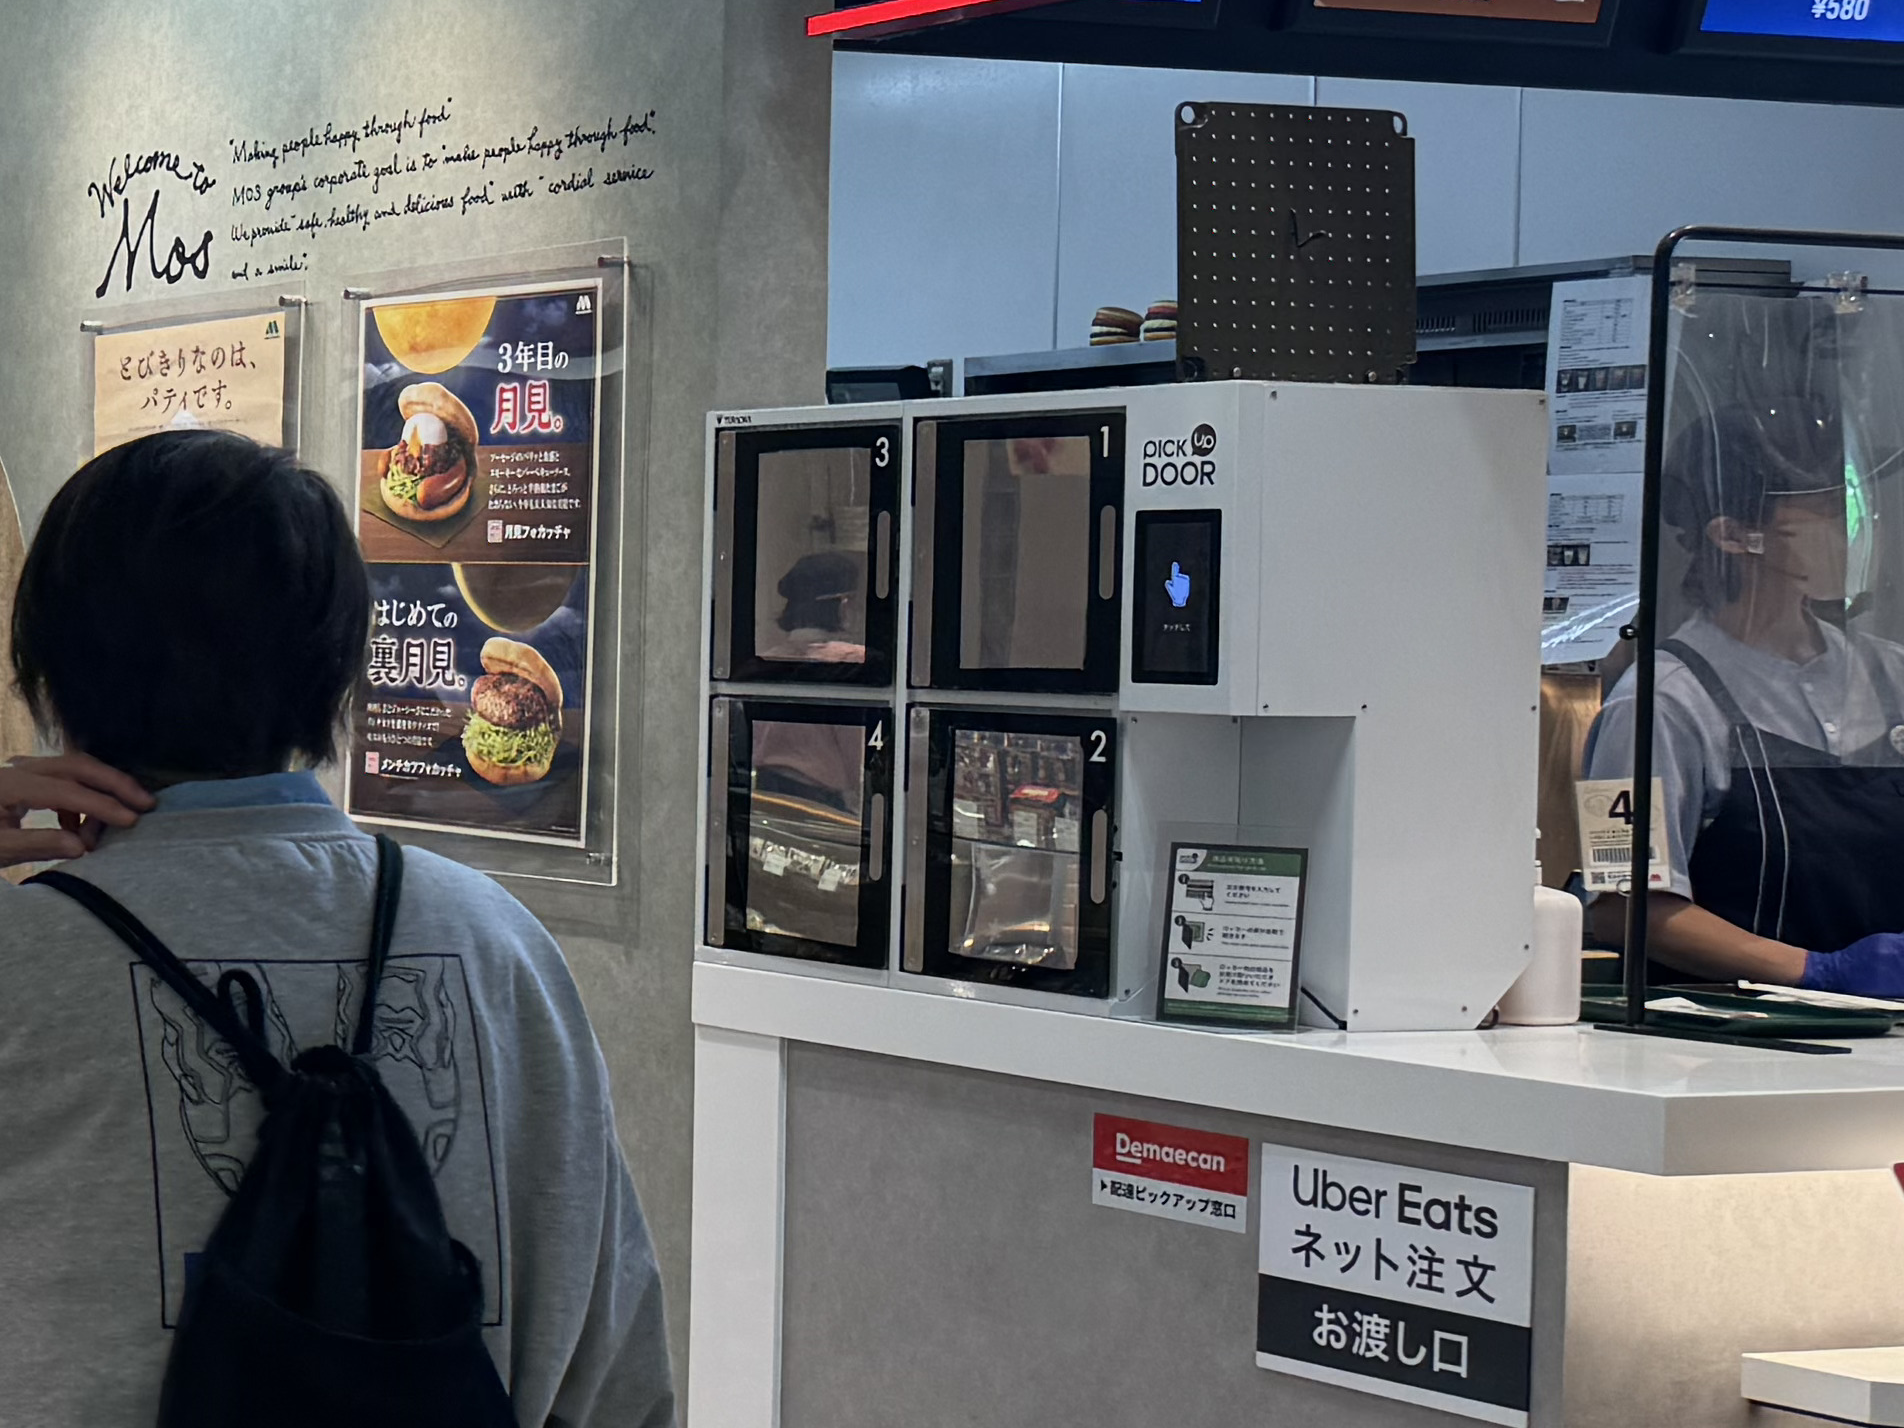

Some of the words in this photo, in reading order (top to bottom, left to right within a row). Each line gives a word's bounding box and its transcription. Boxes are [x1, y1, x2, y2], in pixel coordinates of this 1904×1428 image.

[283, 128, 322, 163] people
[363, 115, 417, 143] through
[232, 185, 261, 206] MOS
[482, 137, 527, 169] people
[565, 118, 617, 152] through
[88, 150, 192, 219] Welcome
[96, 189, 213, 299] Mos
[120, 341, 256, 381] とびきりなのは、
[497, 340, 568, 374] 3年目の
[141, 380, 232, 414] パティです。
[490, 380, 564, 434] 月見。
[875, 437, 890, 468] 3
[1099, 425, 1110, 457] 1
[1142, 460, 1216, 487] DOOR
[371, 598, 457, 630] はじめての
[367, 637, 466, 689] 裏月見。
[868, 720, 884, 750] 4
[1089, 730, 1107, 763] 2
[1116, 1132, 1225, 1172] Demaecan
[1292, 1164, 1388, 1219] Uber
[1398, 1183, 1499, 1240] Eats
[1291, 1223, 1496, 1305] ネット注文
[1312, 1304, 1469, 1379] お渡し口
